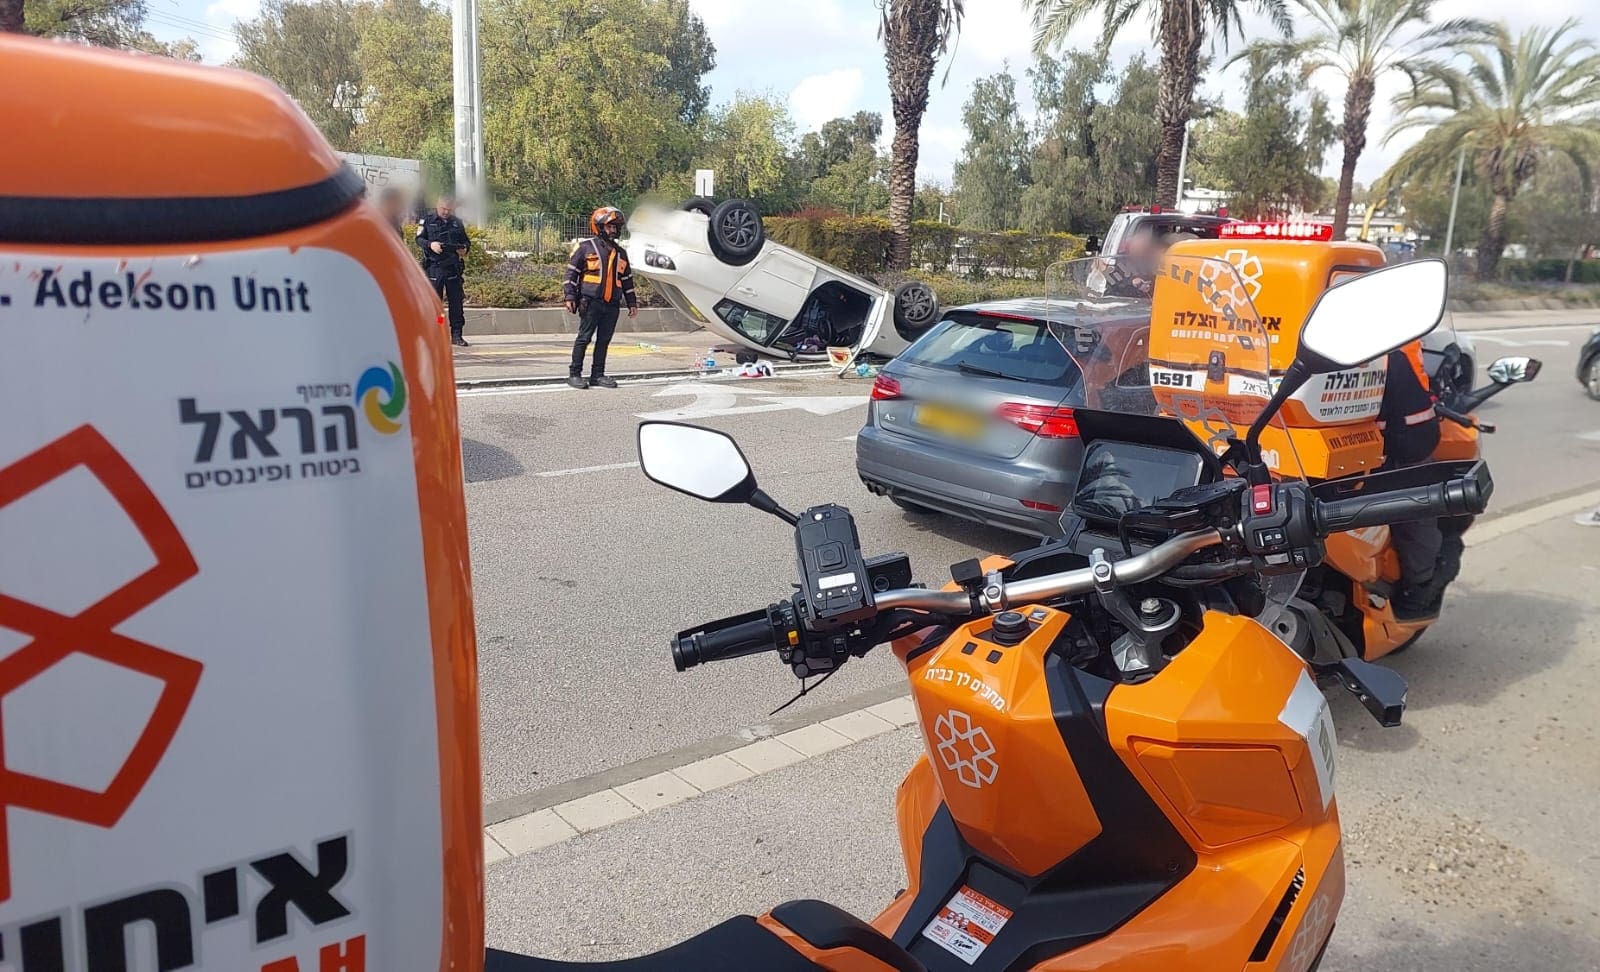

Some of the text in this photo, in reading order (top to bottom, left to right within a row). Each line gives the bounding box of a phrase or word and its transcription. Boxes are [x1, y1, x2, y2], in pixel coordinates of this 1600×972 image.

[34, 268, 312, 312] Adelson Unit
[1173, 310, 1218, 328] הצלה
[1171, 329, 1280, 346] UNITED HATAH
[1152, 372, 1193, 387] 1591
[1324, 371, 1360, 390] הצלה
[296, 383, 352, 403] בשיתוף
[1321, 391, 1352, 402] UNITED
[178, 397, 359, 463] הראל
[185, 457, 361, 489] ביטוח ופיננסים
[956, 671, 971, 687] לך
[0, 835, 351, 972] איחו
